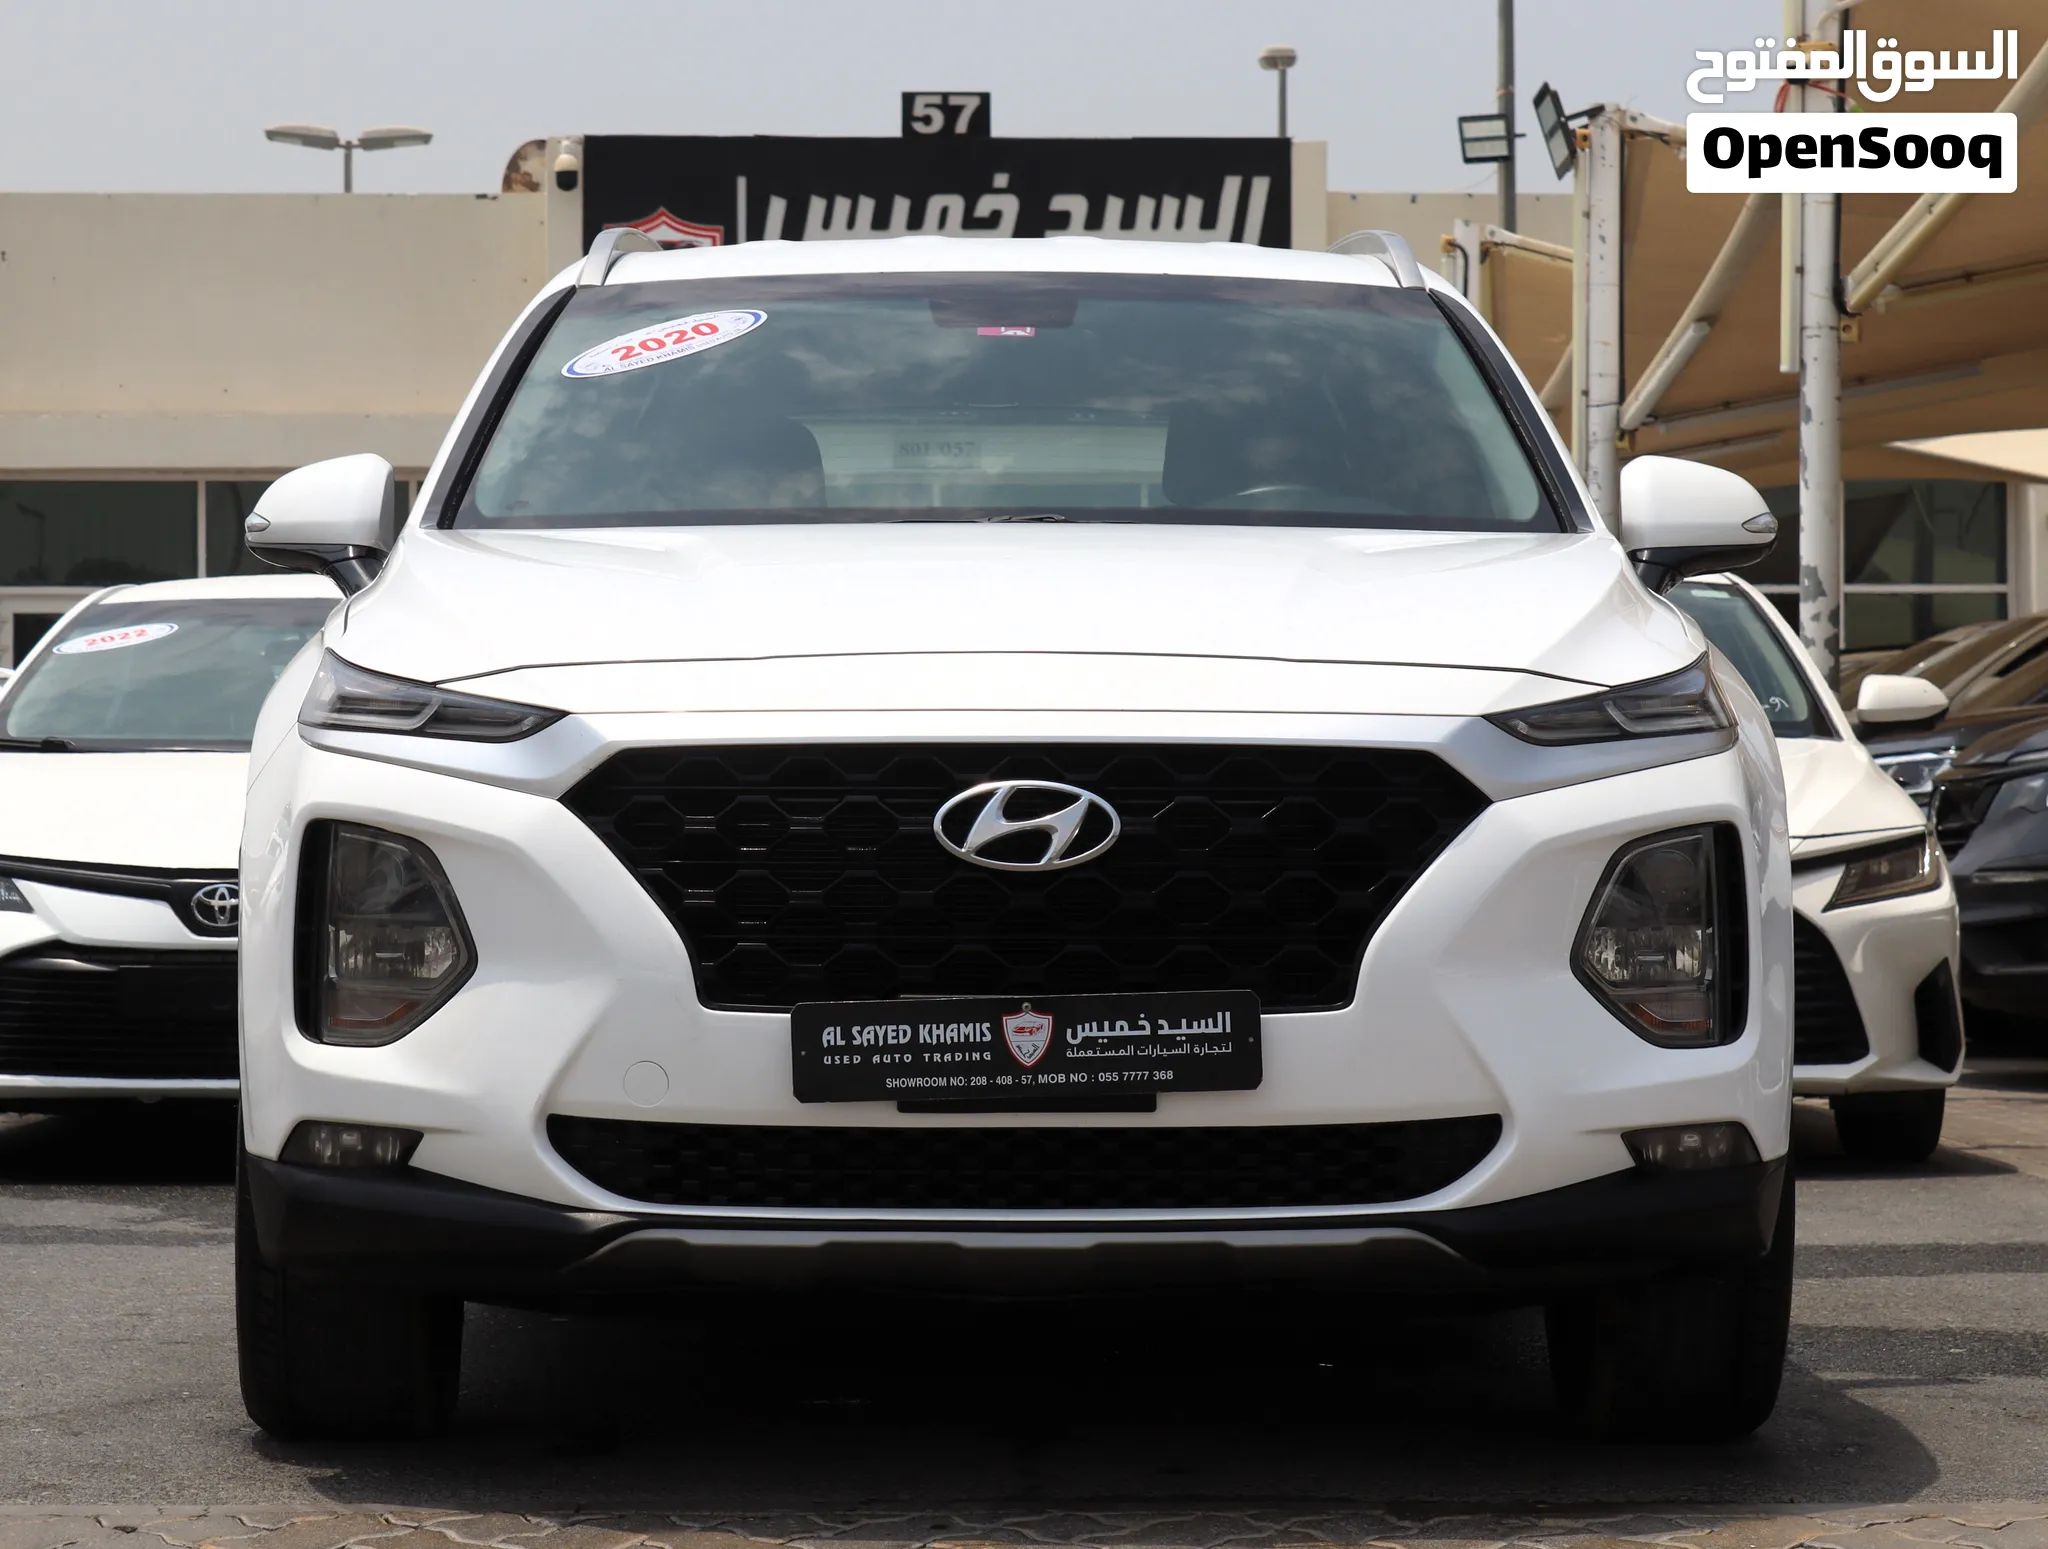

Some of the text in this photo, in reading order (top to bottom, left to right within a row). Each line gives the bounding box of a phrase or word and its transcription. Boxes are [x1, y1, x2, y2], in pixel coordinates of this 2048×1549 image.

[911, 94, 981, 135] 57
[611, 322, 719, 361] 2020
[84, 628, 149, 647] 2022
[822, 1022, 992, 1048] AL SAYED KHAMIS
[1066, 1011, 1231, 1045] السيد خميس
[823, 1051, 992, 1065] USED AUTO TRADING
[1066, 1041, 1232, 1058] لتجارة السيارات المستعملة
[886, 1077, 947, 1088] SHOWROOM
[950, 1076, 968, 1087] NO:
[970, 1076, 987, 1086] 208
[995, 1075, 1013, 1086] 408
[1021, 1074, 1035, 1086] 57,
[1038, 1074, 1066, 1084] MOB
[1070, 1072, 1088, 1083] NO
[1098, 1071, 1119, 1082] 055
[1122, 1071, 1149, 1082] 7777
[1152, 1070, 1174, 1080] 368
